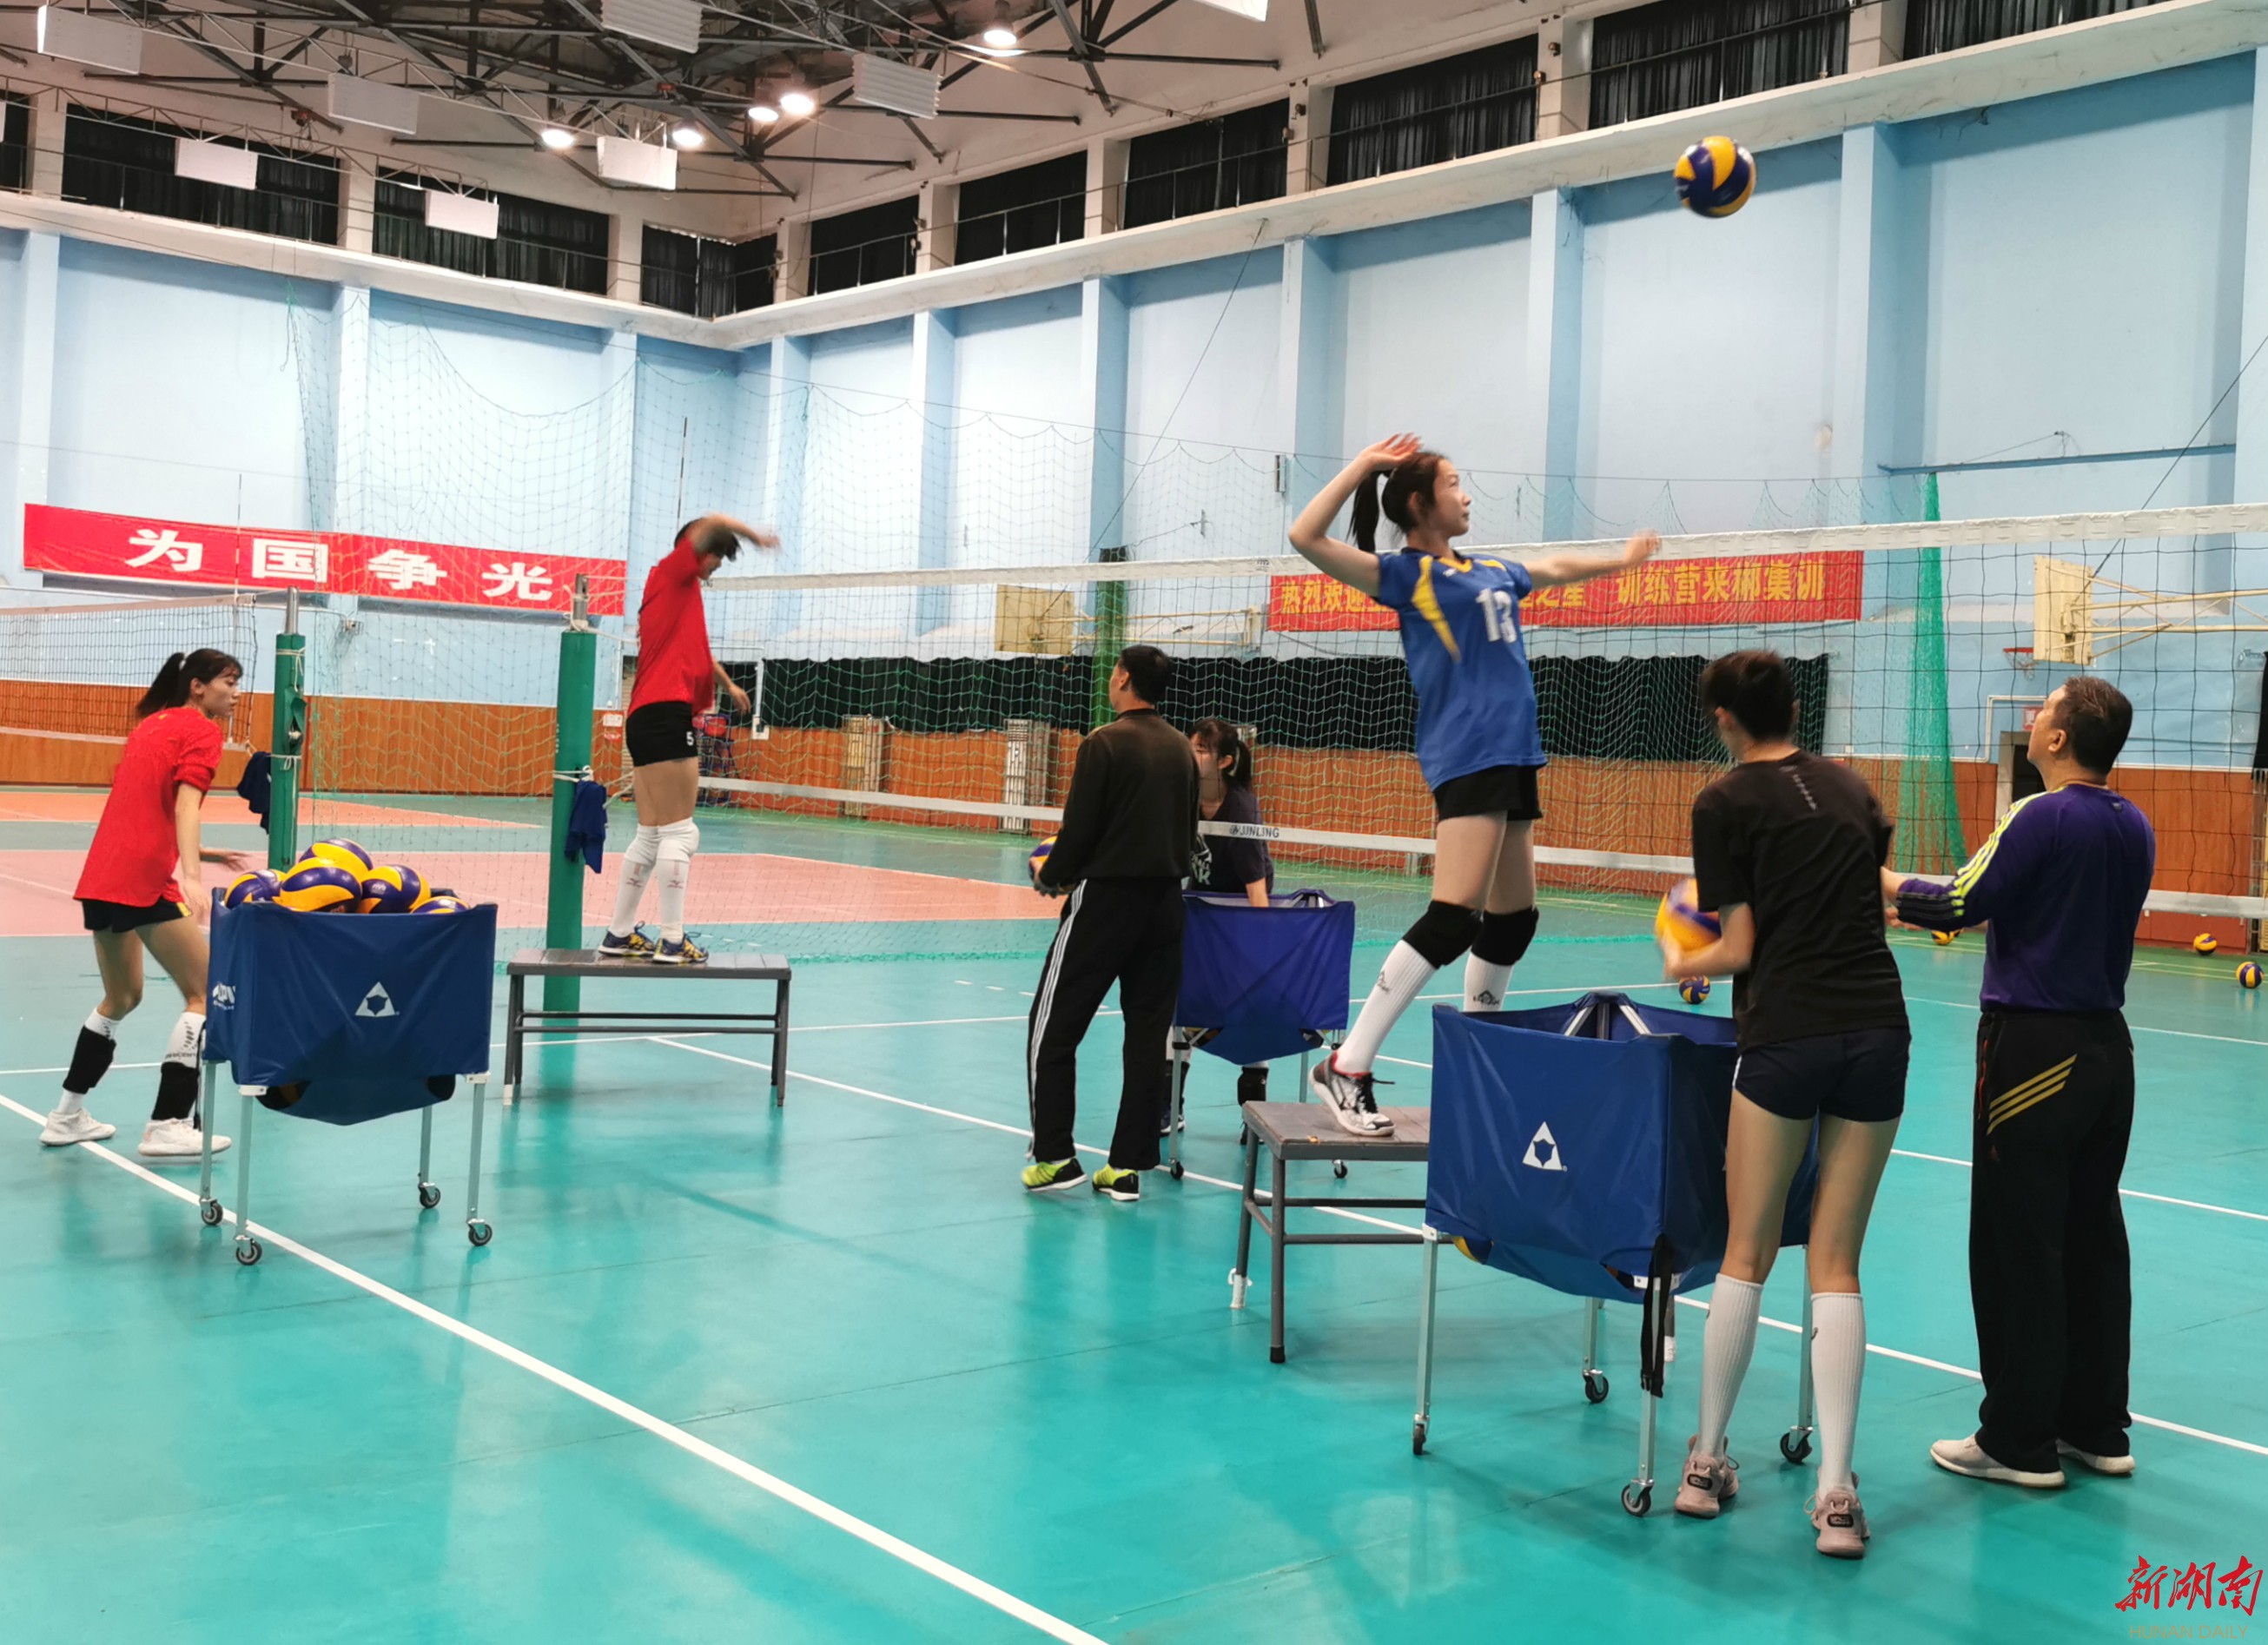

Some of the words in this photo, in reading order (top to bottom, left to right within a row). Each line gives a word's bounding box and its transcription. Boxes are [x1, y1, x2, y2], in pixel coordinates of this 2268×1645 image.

[126, 528, 553, 602] 为国争光
[1476, 588, 1517, 643] 13
[1239, 825, 1279, 838] JINLING
